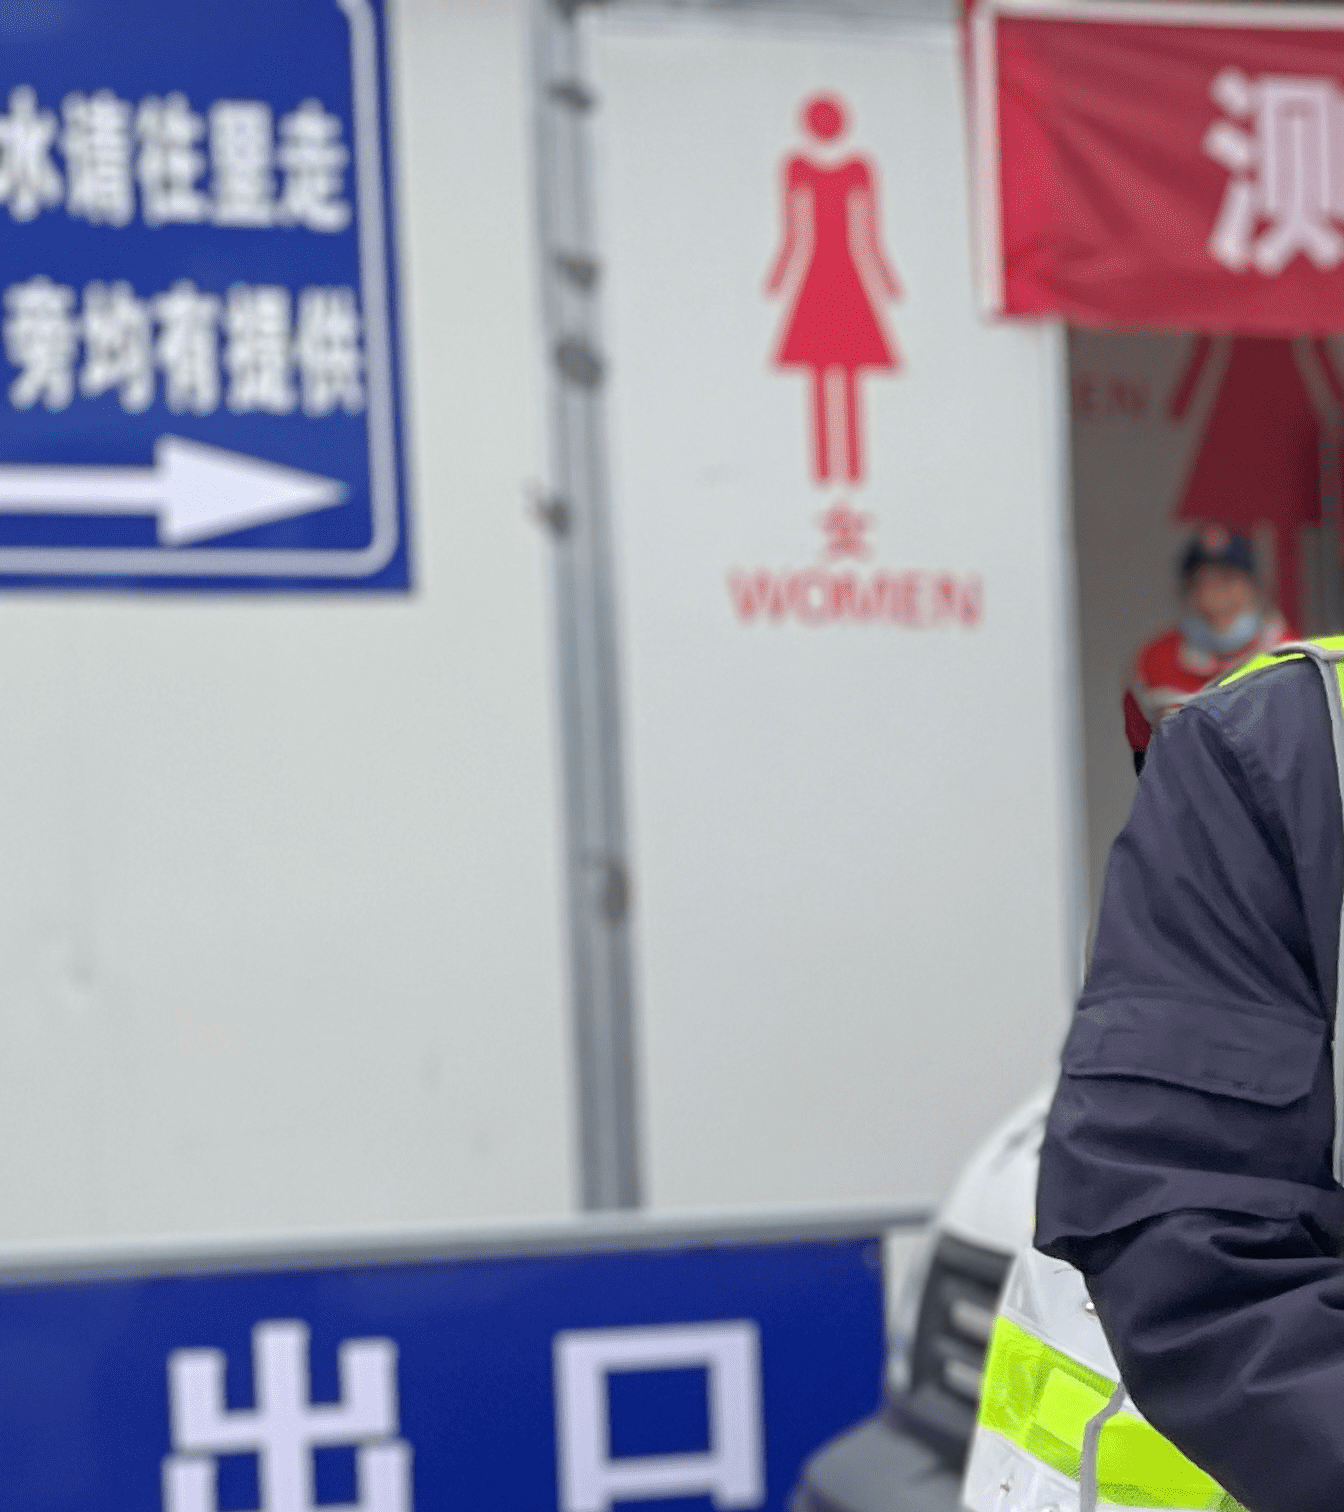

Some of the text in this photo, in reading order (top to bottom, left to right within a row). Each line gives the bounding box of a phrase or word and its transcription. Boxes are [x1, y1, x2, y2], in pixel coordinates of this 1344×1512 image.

[0, 86, 350, 232] 水请往里走
[6, 276, 370, 414] 旁均有提供
[727, 567, 983, 630] WOMEN
